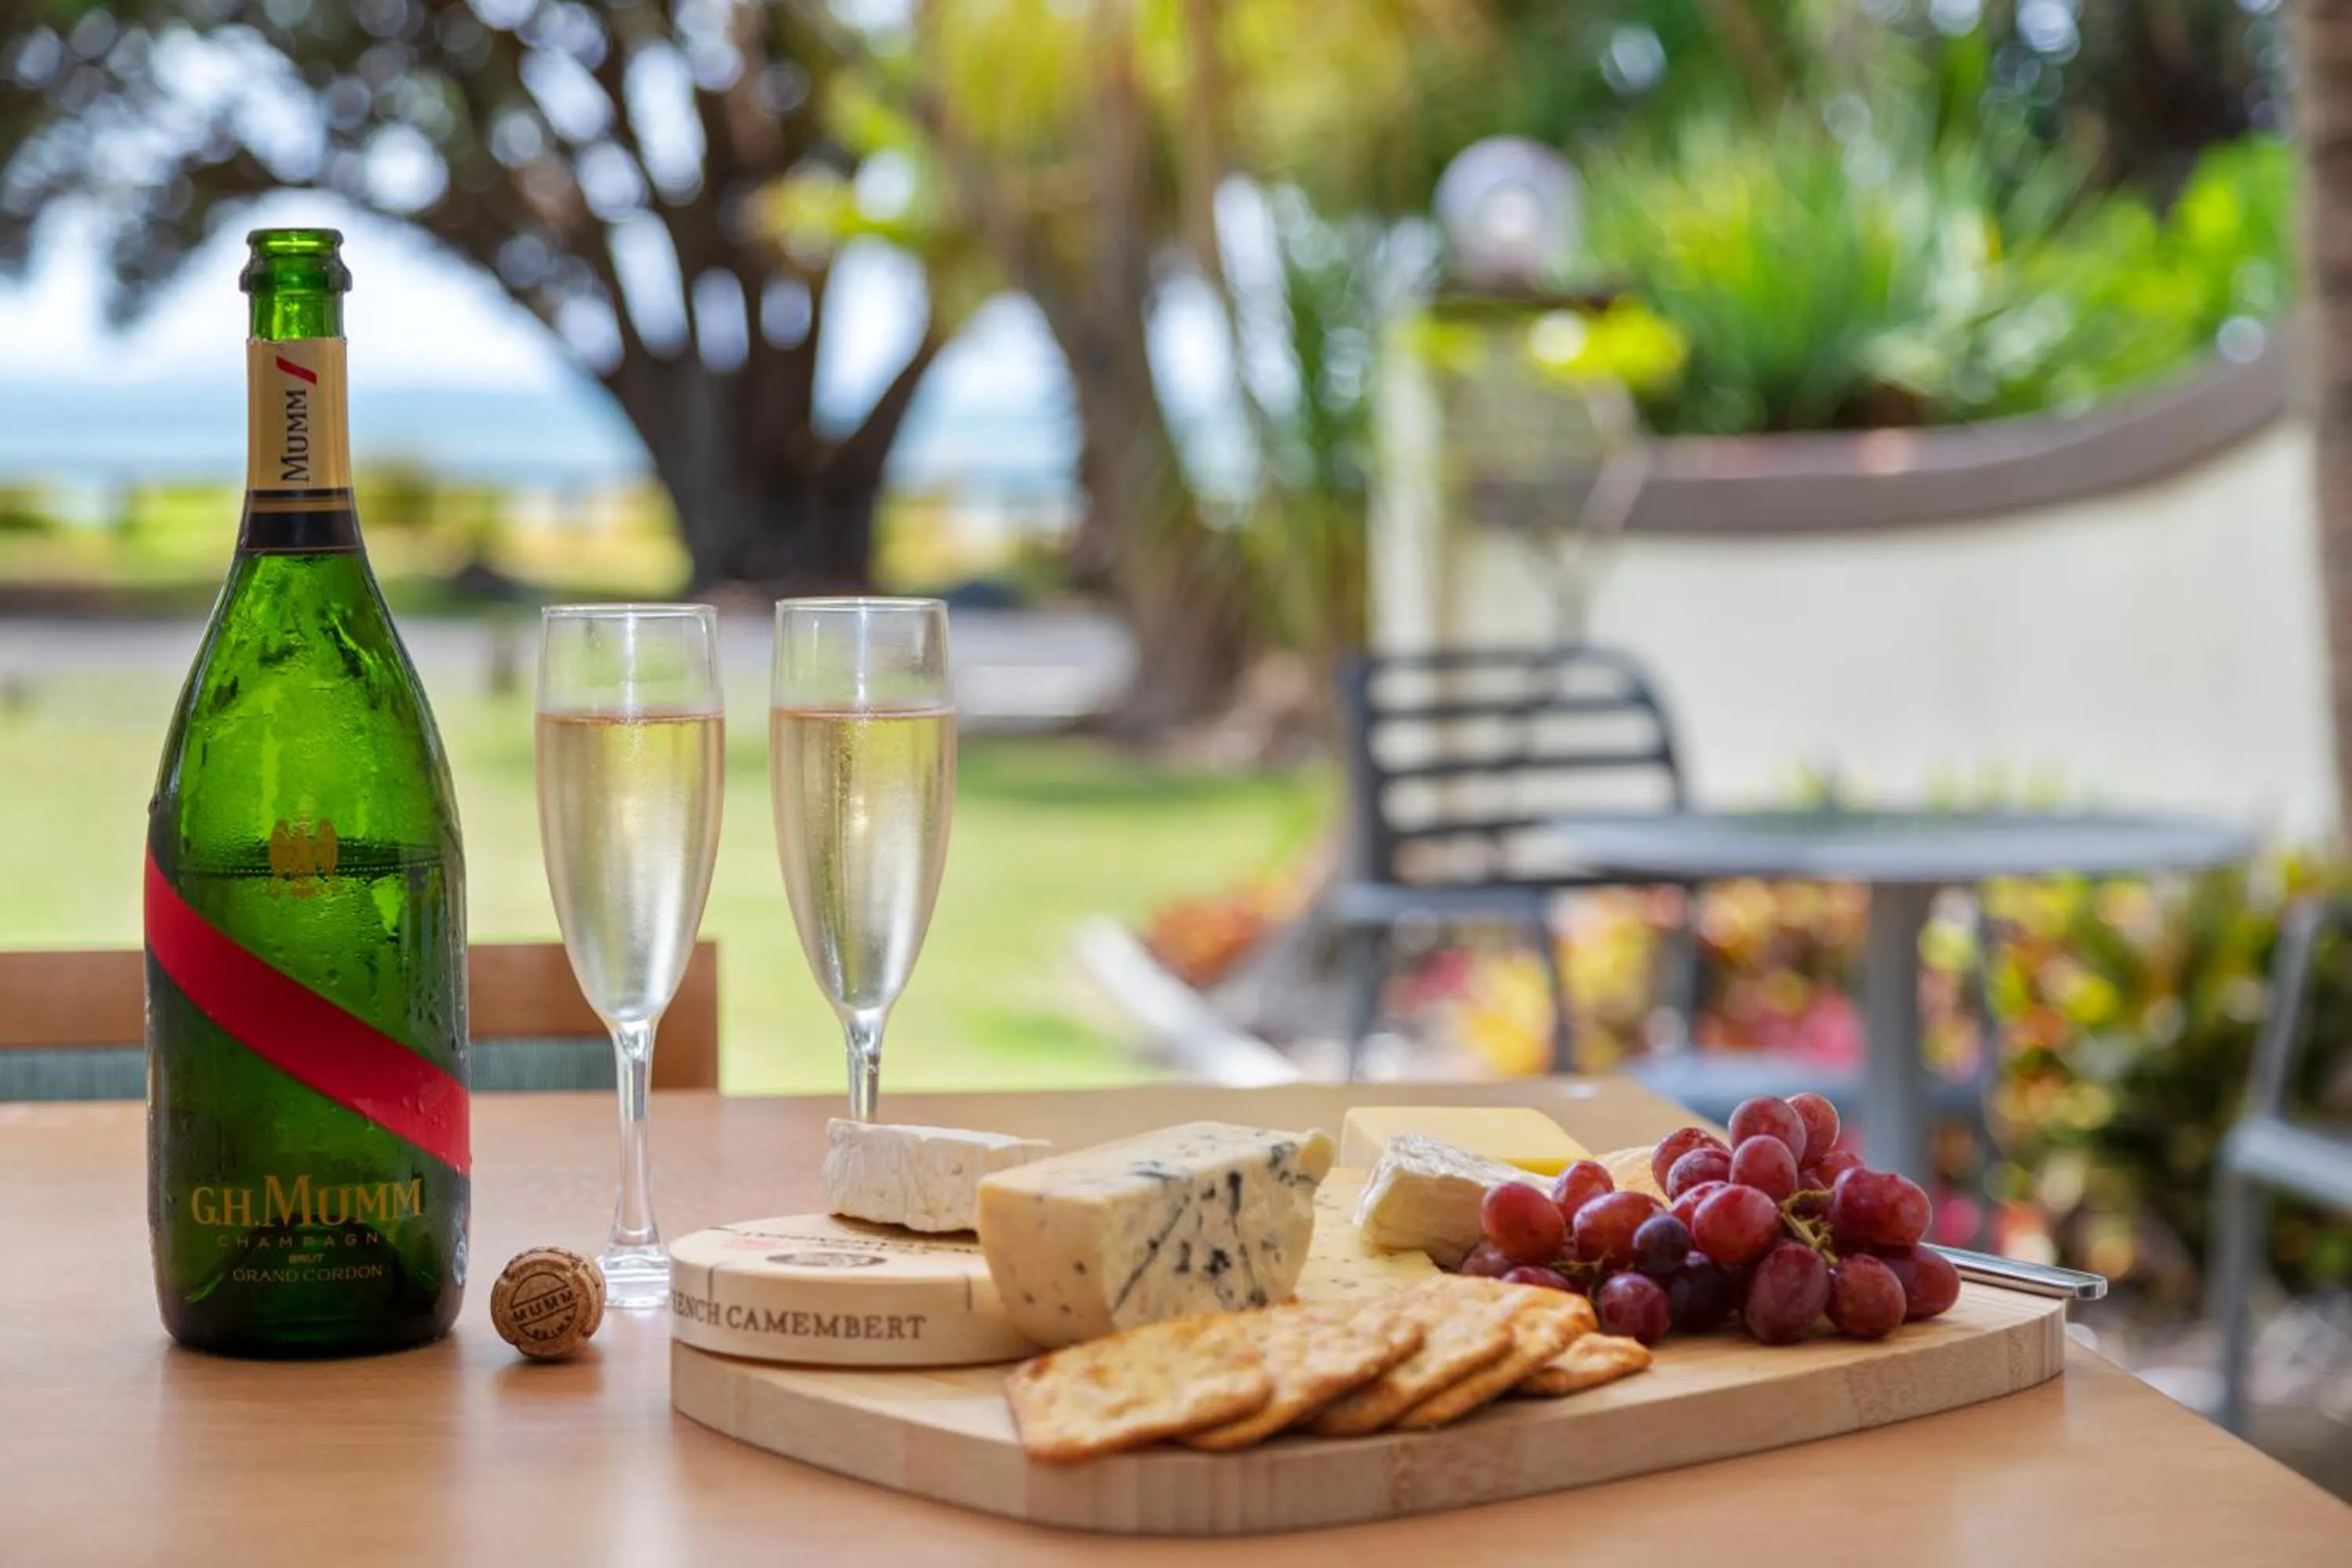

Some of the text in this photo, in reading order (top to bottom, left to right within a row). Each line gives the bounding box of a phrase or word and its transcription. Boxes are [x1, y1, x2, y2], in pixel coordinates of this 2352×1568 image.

[280, 389, 309, 482] MUMM
[216, 1230, 396, 1248] CHAMPAGNE
[232, 1265, 383, 1283] GRAND CORDON
[514, 1290, 574, 1321] MUMM
[672, 1290, 926, 1340] ENCH CAMEMBERT
